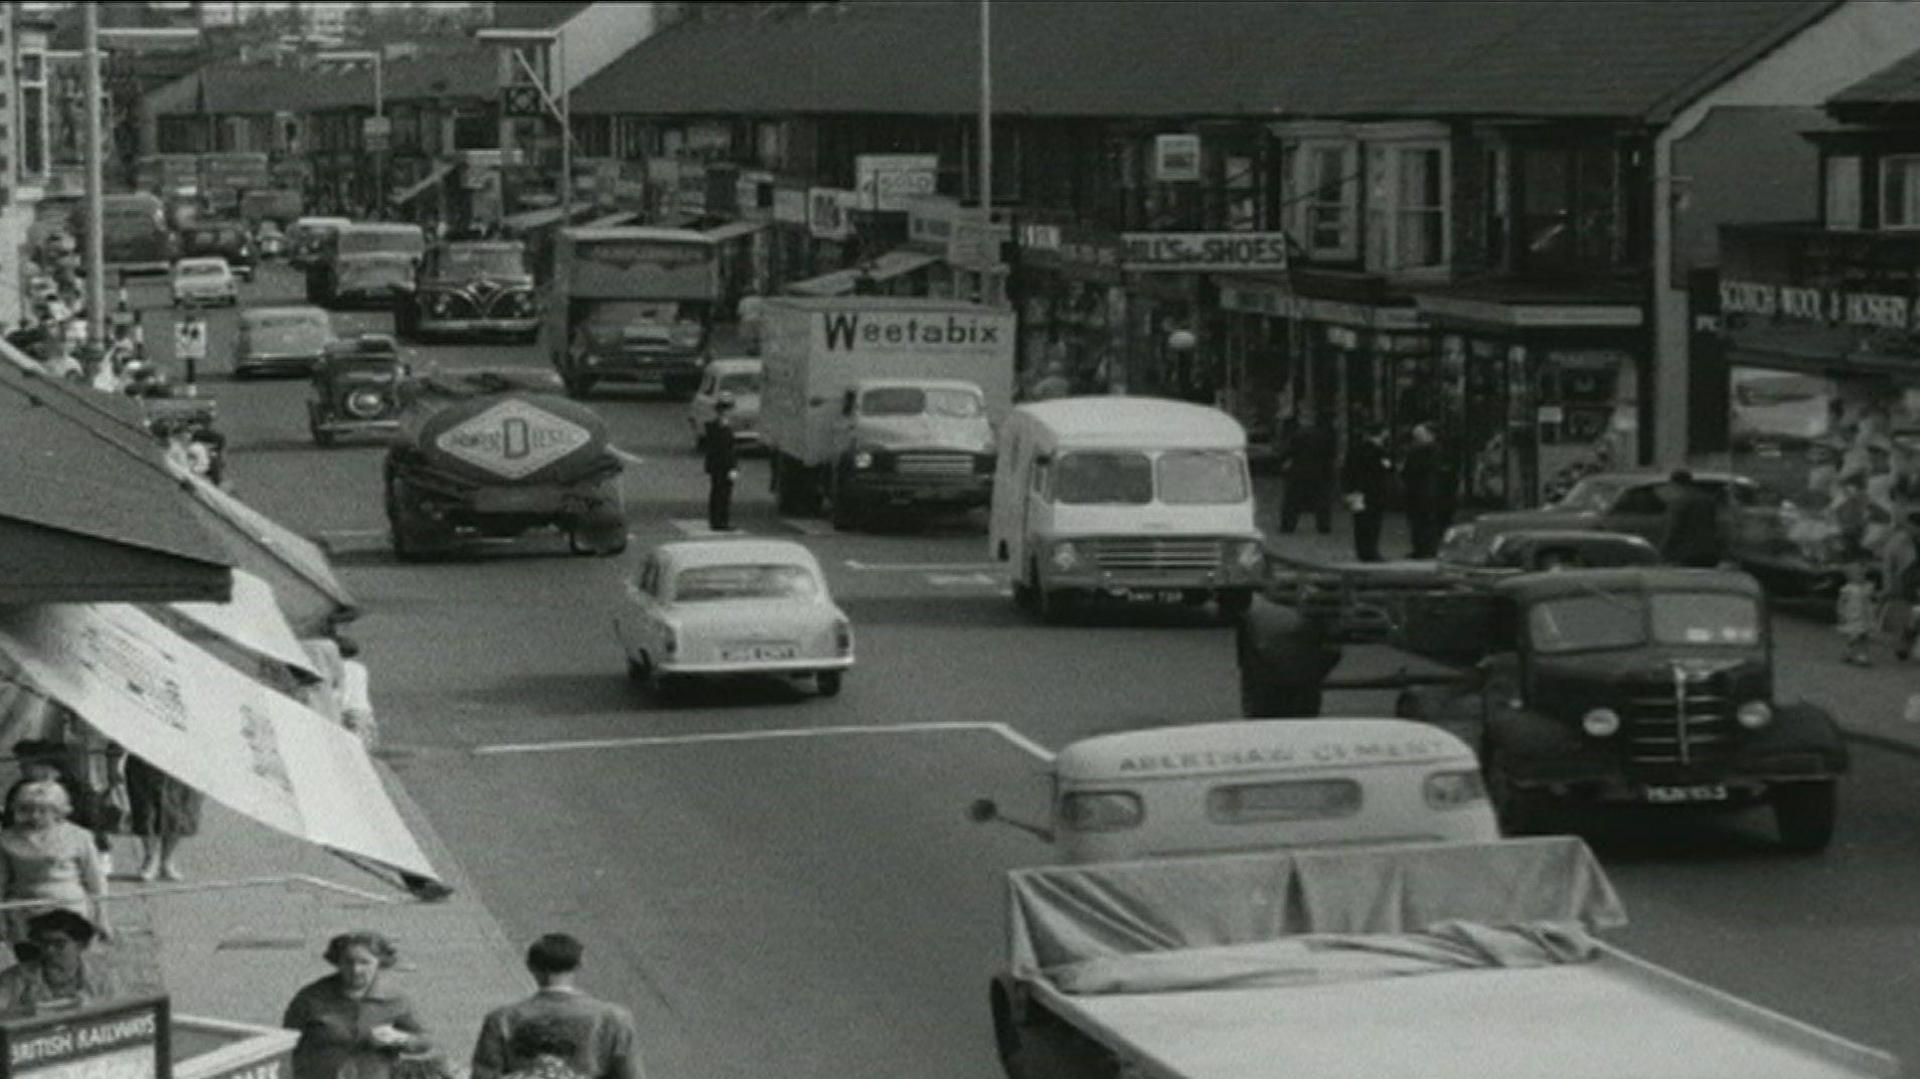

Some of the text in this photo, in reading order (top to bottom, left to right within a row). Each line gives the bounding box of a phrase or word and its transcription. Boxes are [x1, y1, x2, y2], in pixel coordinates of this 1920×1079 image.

[1202, 237, 1283, 264] SHOES
[1780, 286, 1822, 321] WOOL
[824, 312, 998, 351] Weetabix
[1311, 740, 1443, 761] CEMENT
[10, 1013, 156, 1066] BRITISH RAILWAYS
